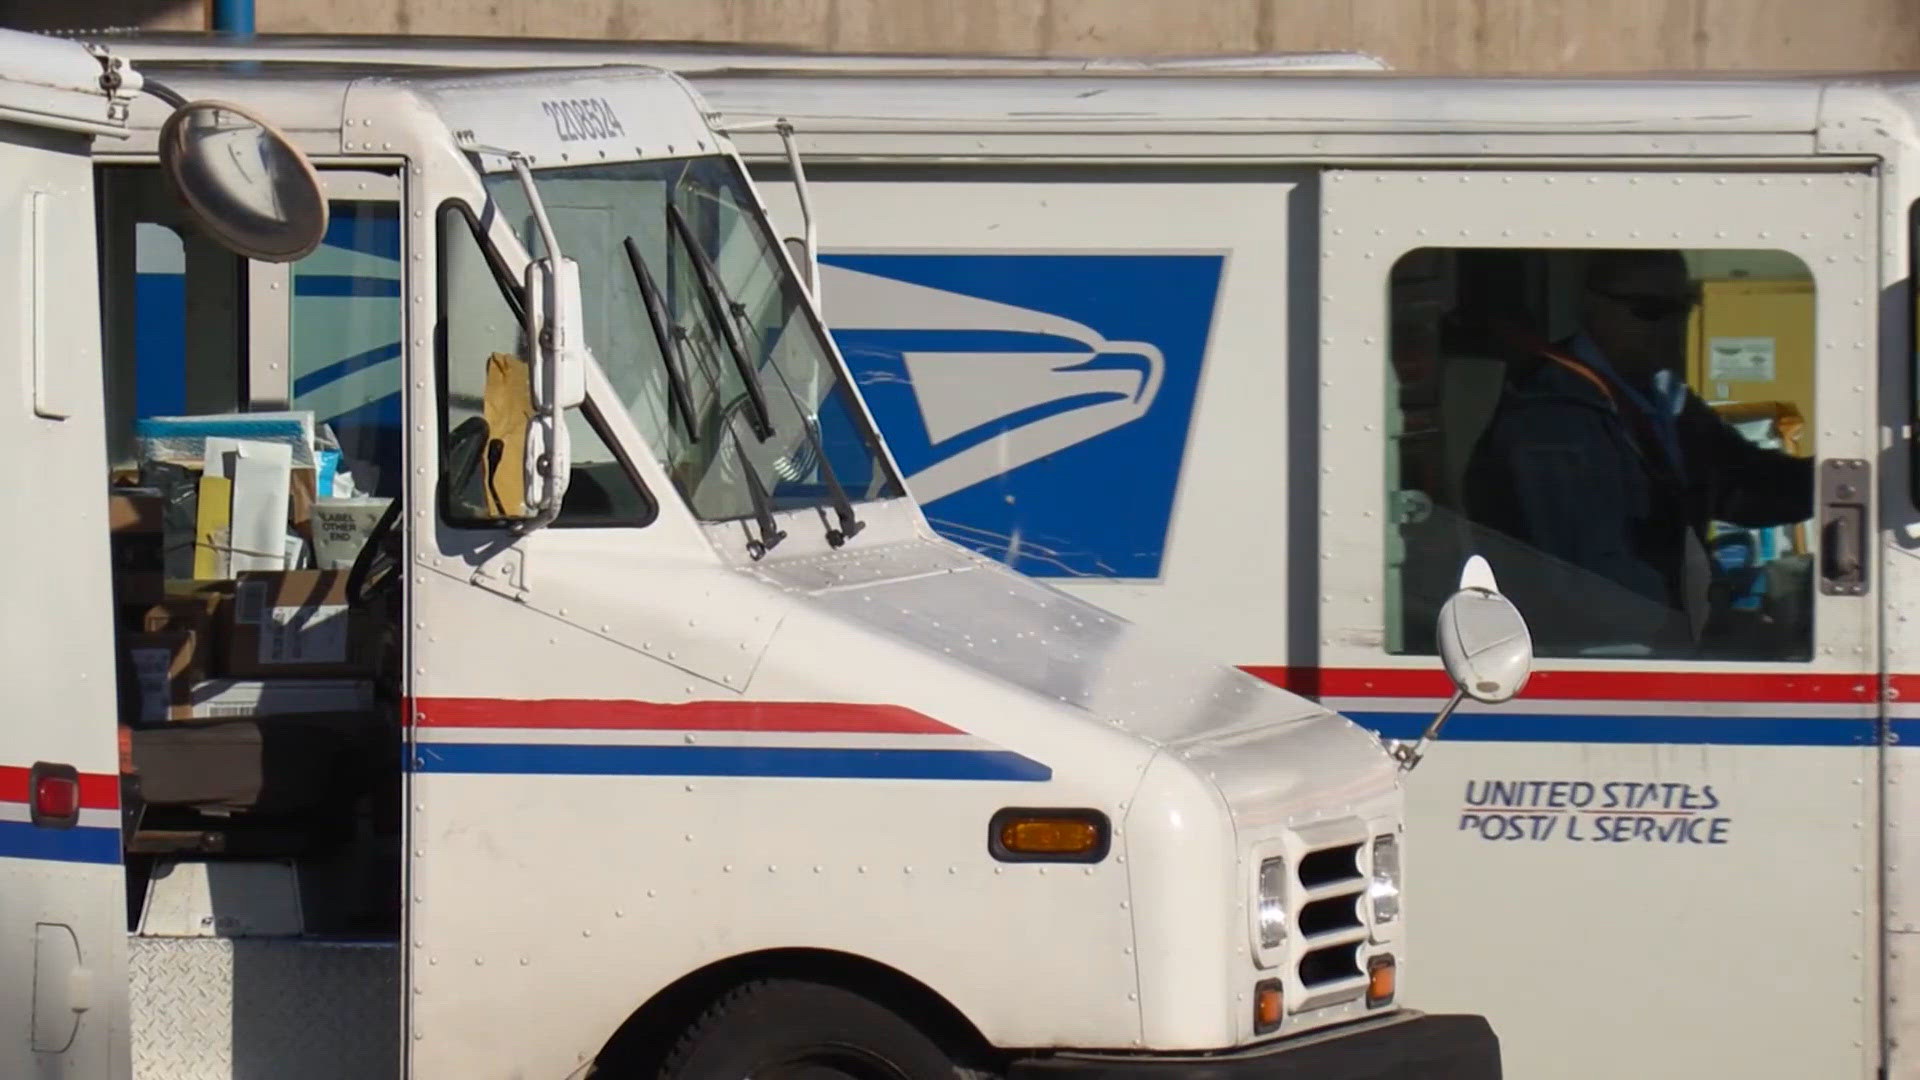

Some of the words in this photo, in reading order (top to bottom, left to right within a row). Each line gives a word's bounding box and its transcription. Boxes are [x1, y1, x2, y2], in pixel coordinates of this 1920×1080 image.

[542, 98, 625, 141] 2208524
[322, 512, 355, 522] LABEL
[322, 522, 356, 531] OTHER
[330, 532, 351, 541] END
[1465, 780, 1595, 808] UNITED
[1602, 782, 1719, 809] STATES
[1591, 816, 1732, 844] SERVICE
